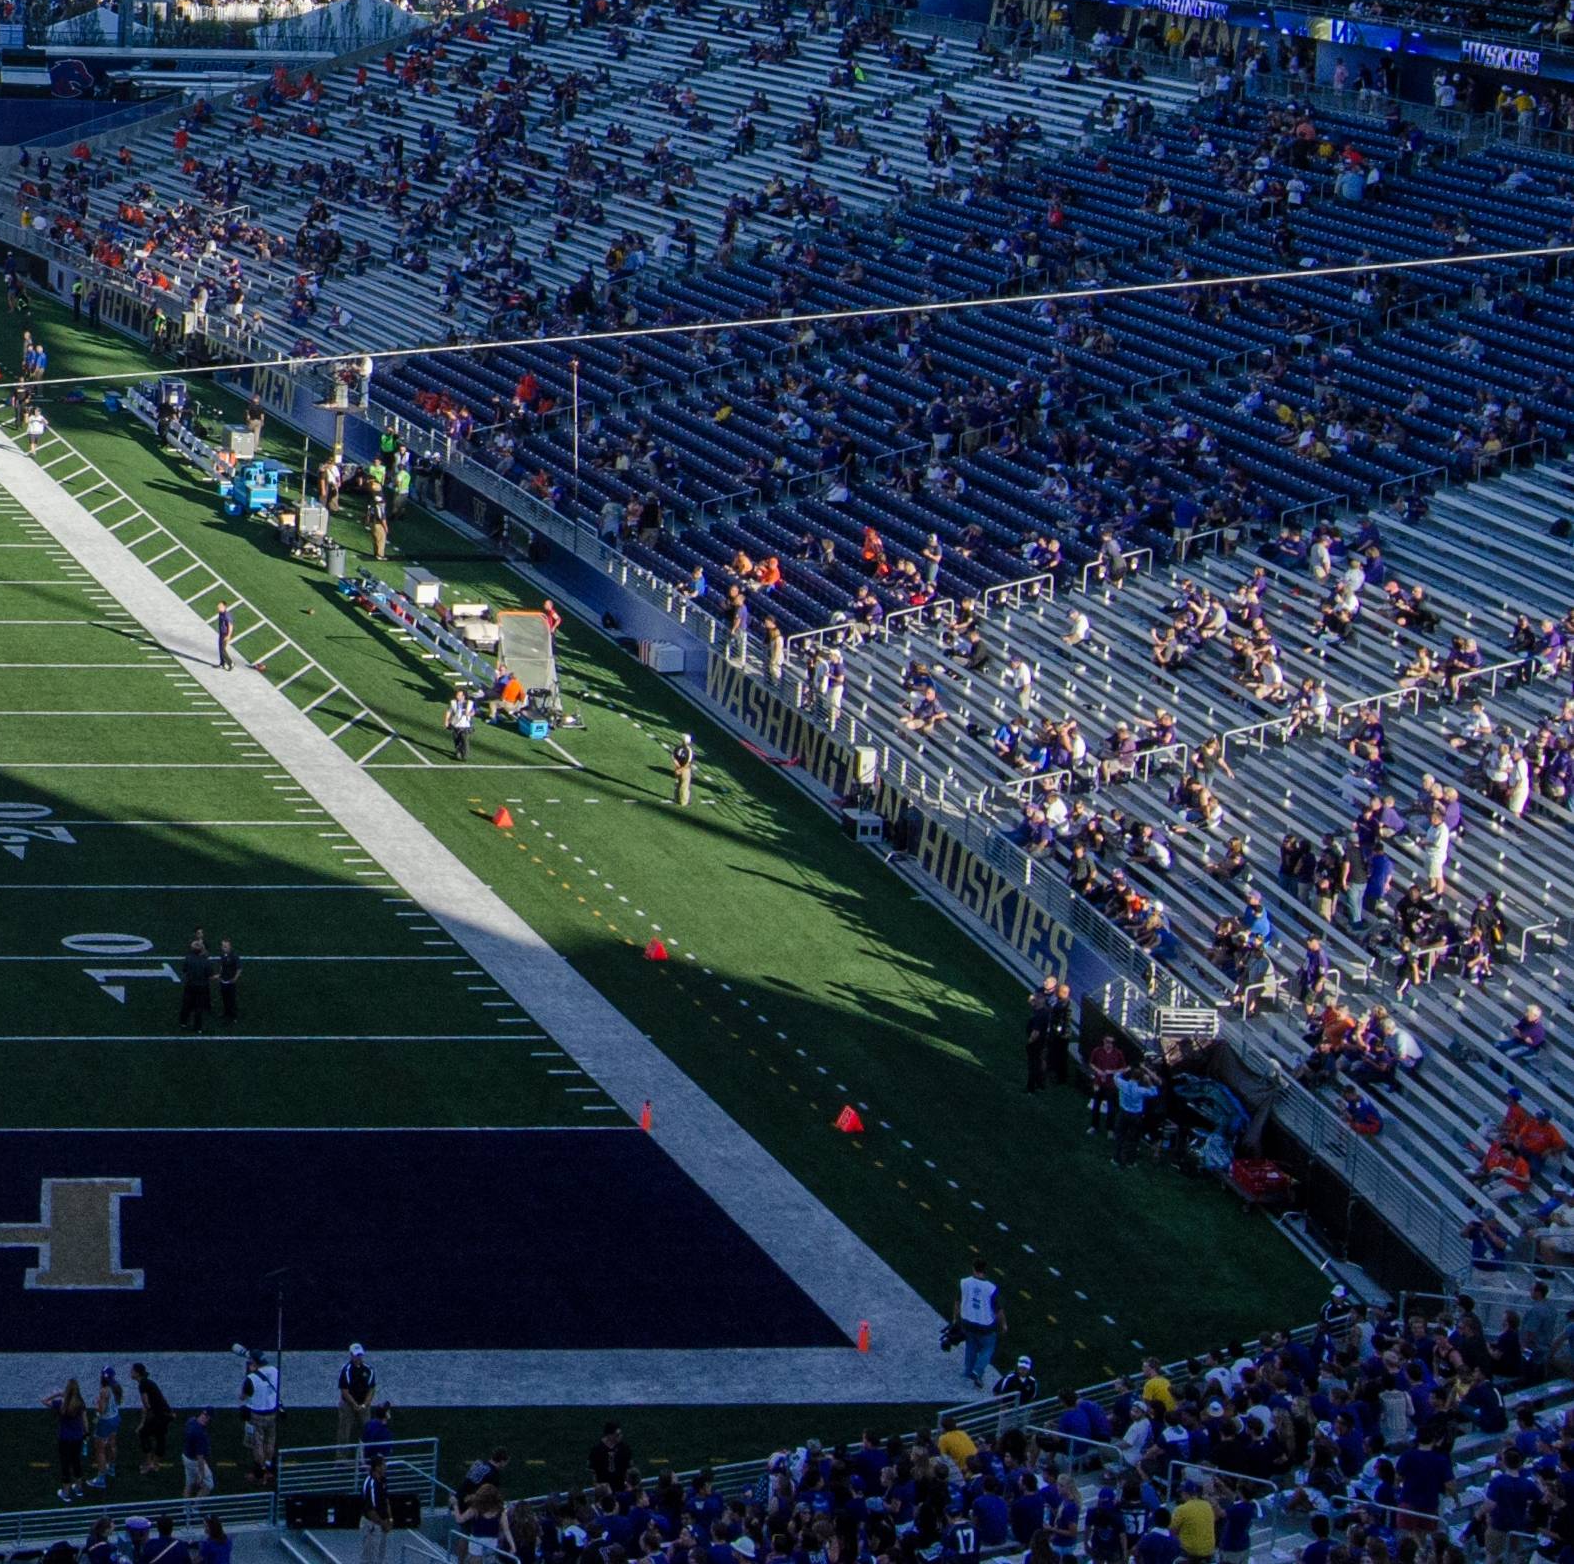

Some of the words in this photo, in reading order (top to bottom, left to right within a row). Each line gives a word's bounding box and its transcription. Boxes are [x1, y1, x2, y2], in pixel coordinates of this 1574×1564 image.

[1461, 40, 1540, 75] HUSKIES
[917, 816, 1075, 988] HUSKIES
[60, 933, 182, 984] 10
[956, 1528, 974, 1554] 17
